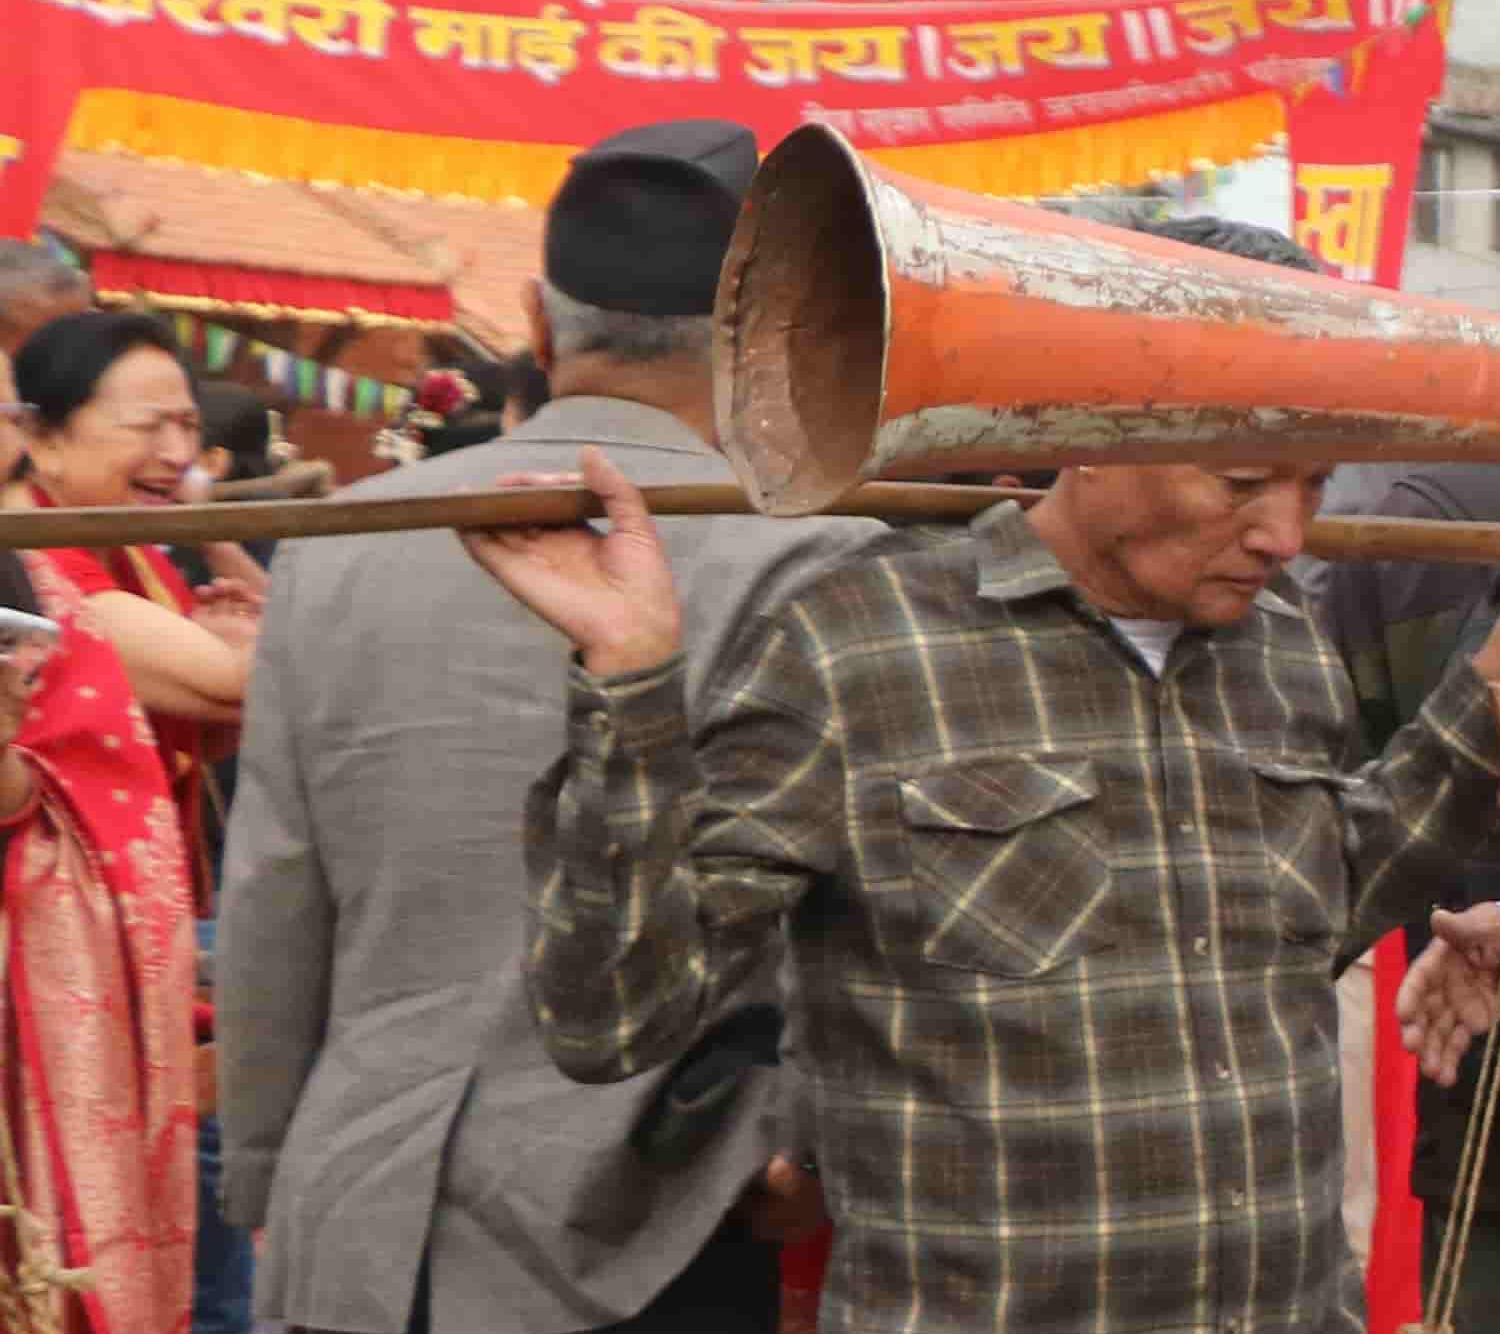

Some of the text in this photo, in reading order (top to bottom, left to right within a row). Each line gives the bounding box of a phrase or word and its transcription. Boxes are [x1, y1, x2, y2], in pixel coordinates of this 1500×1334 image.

[597, 4, 727, 83] की
[739, 25, 911, 88] जय
[943, 11, 1112, 81] जय
